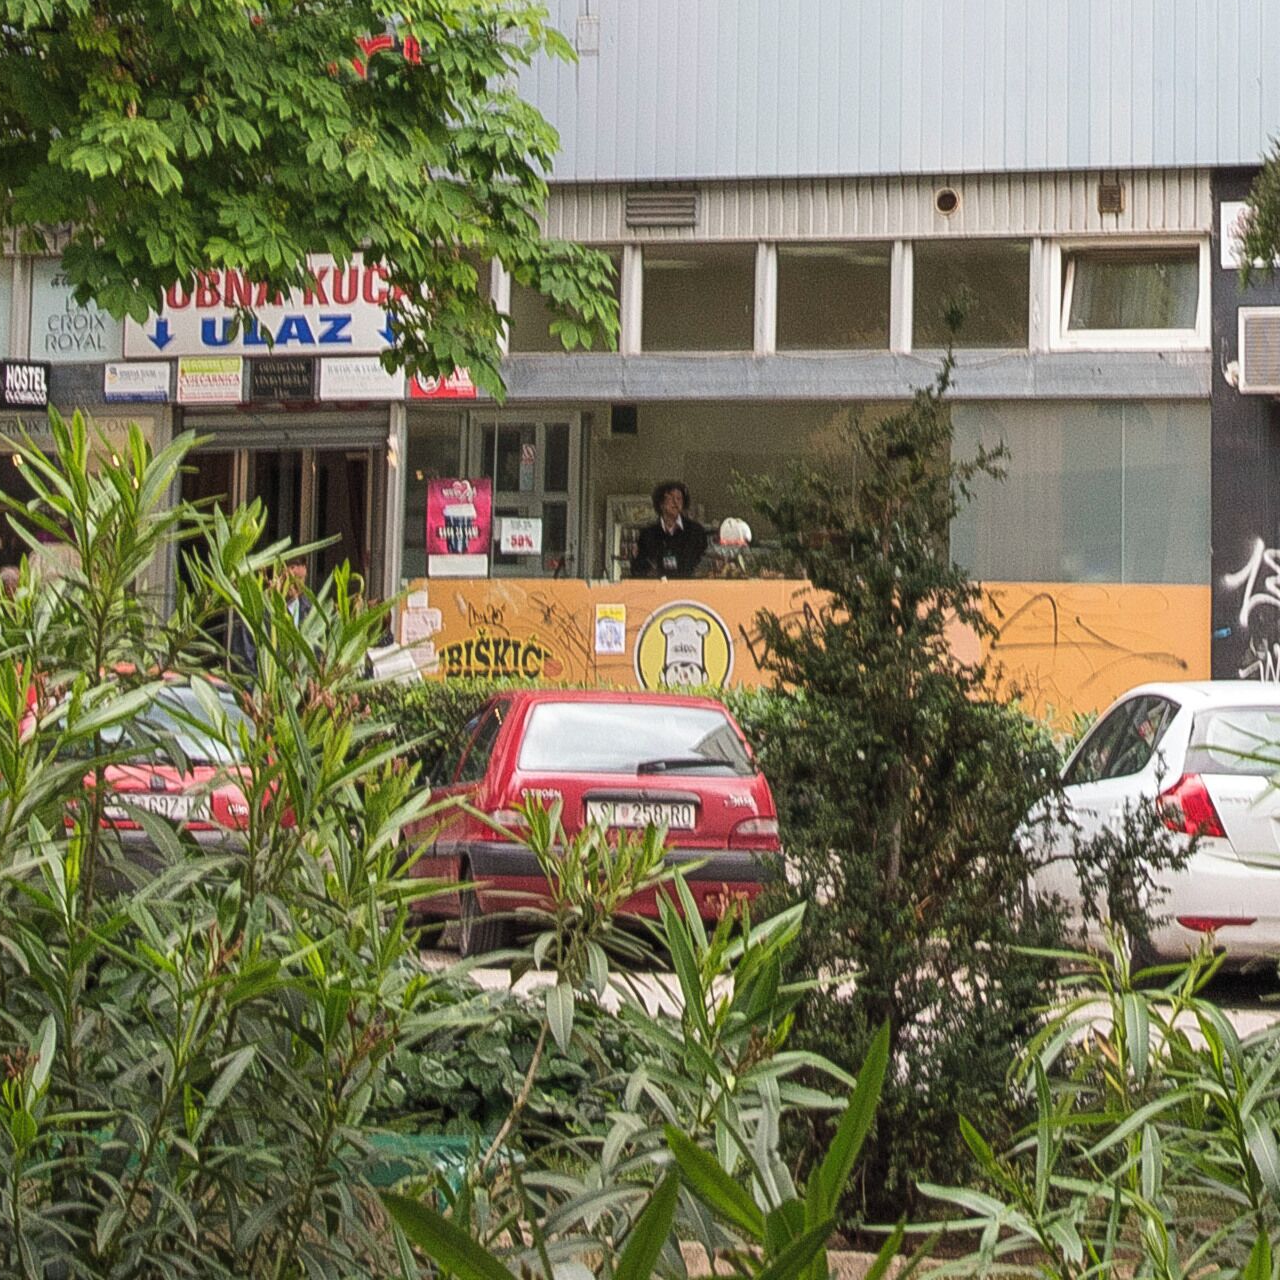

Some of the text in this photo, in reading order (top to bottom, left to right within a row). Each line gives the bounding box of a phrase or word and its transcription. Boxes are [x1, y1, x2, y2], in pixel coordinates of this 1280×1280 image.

[47, 314, 105, 332] CROIX
[201, 314, 352, 347] ULAZ
[45, 332, 107, 353] ROYAL
[5, 363, 48, 392] HOSTEL
[600, 802, 618, 824] ST
